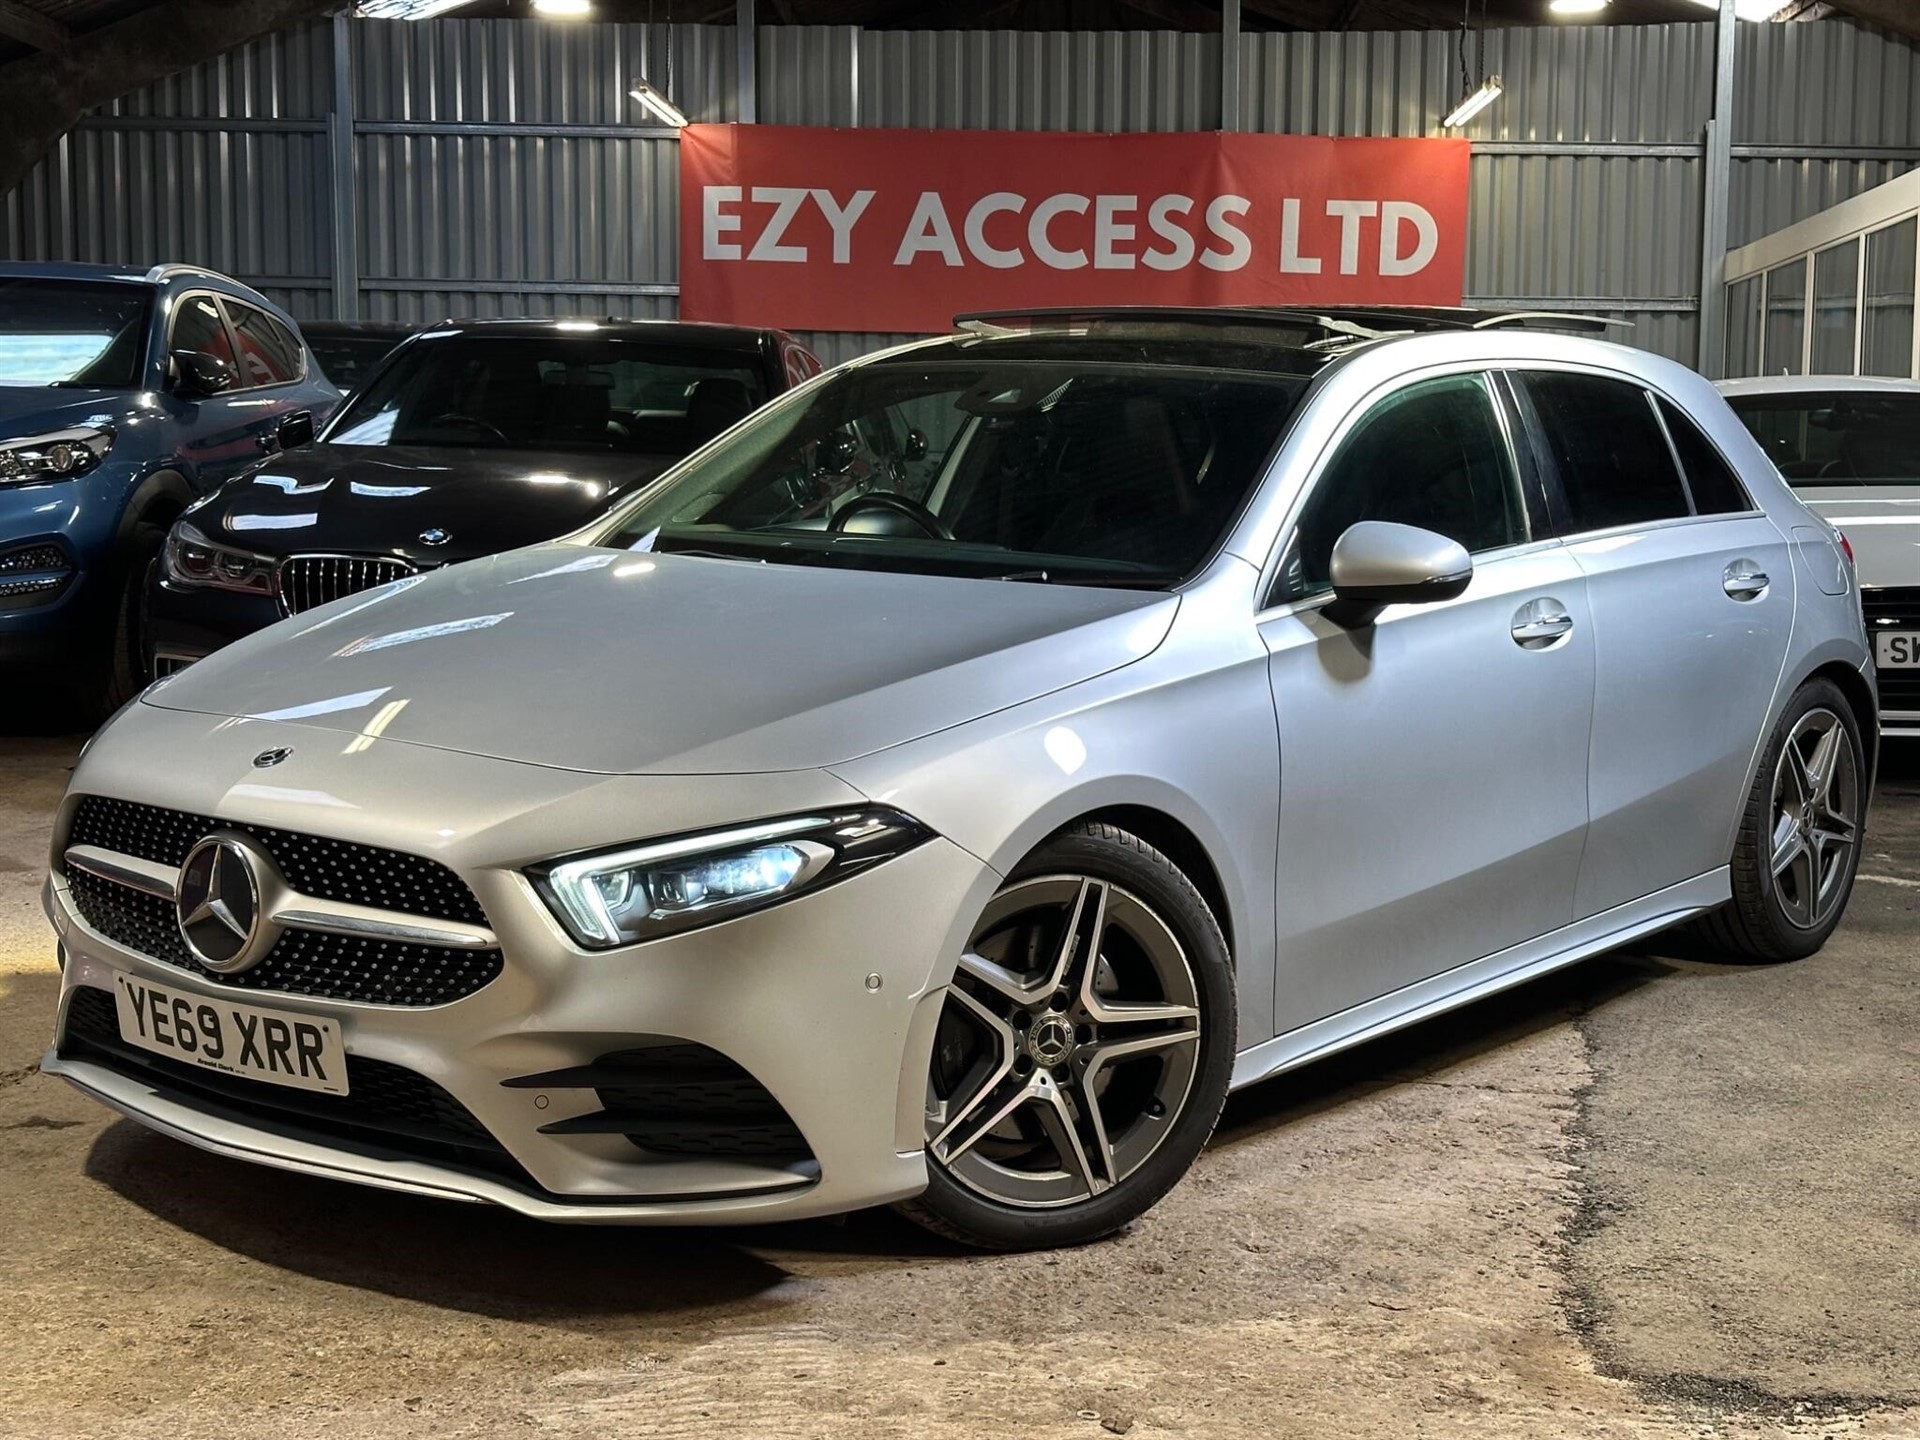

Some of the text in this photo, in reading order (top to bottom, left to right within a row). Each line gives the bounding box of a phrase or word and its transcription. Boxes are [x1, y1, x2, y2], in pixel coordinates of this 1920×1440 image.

[704, 185, 1439, 276] EZY ACCESS LTD
[126, 982, 328, 1081] YE69 XRR
